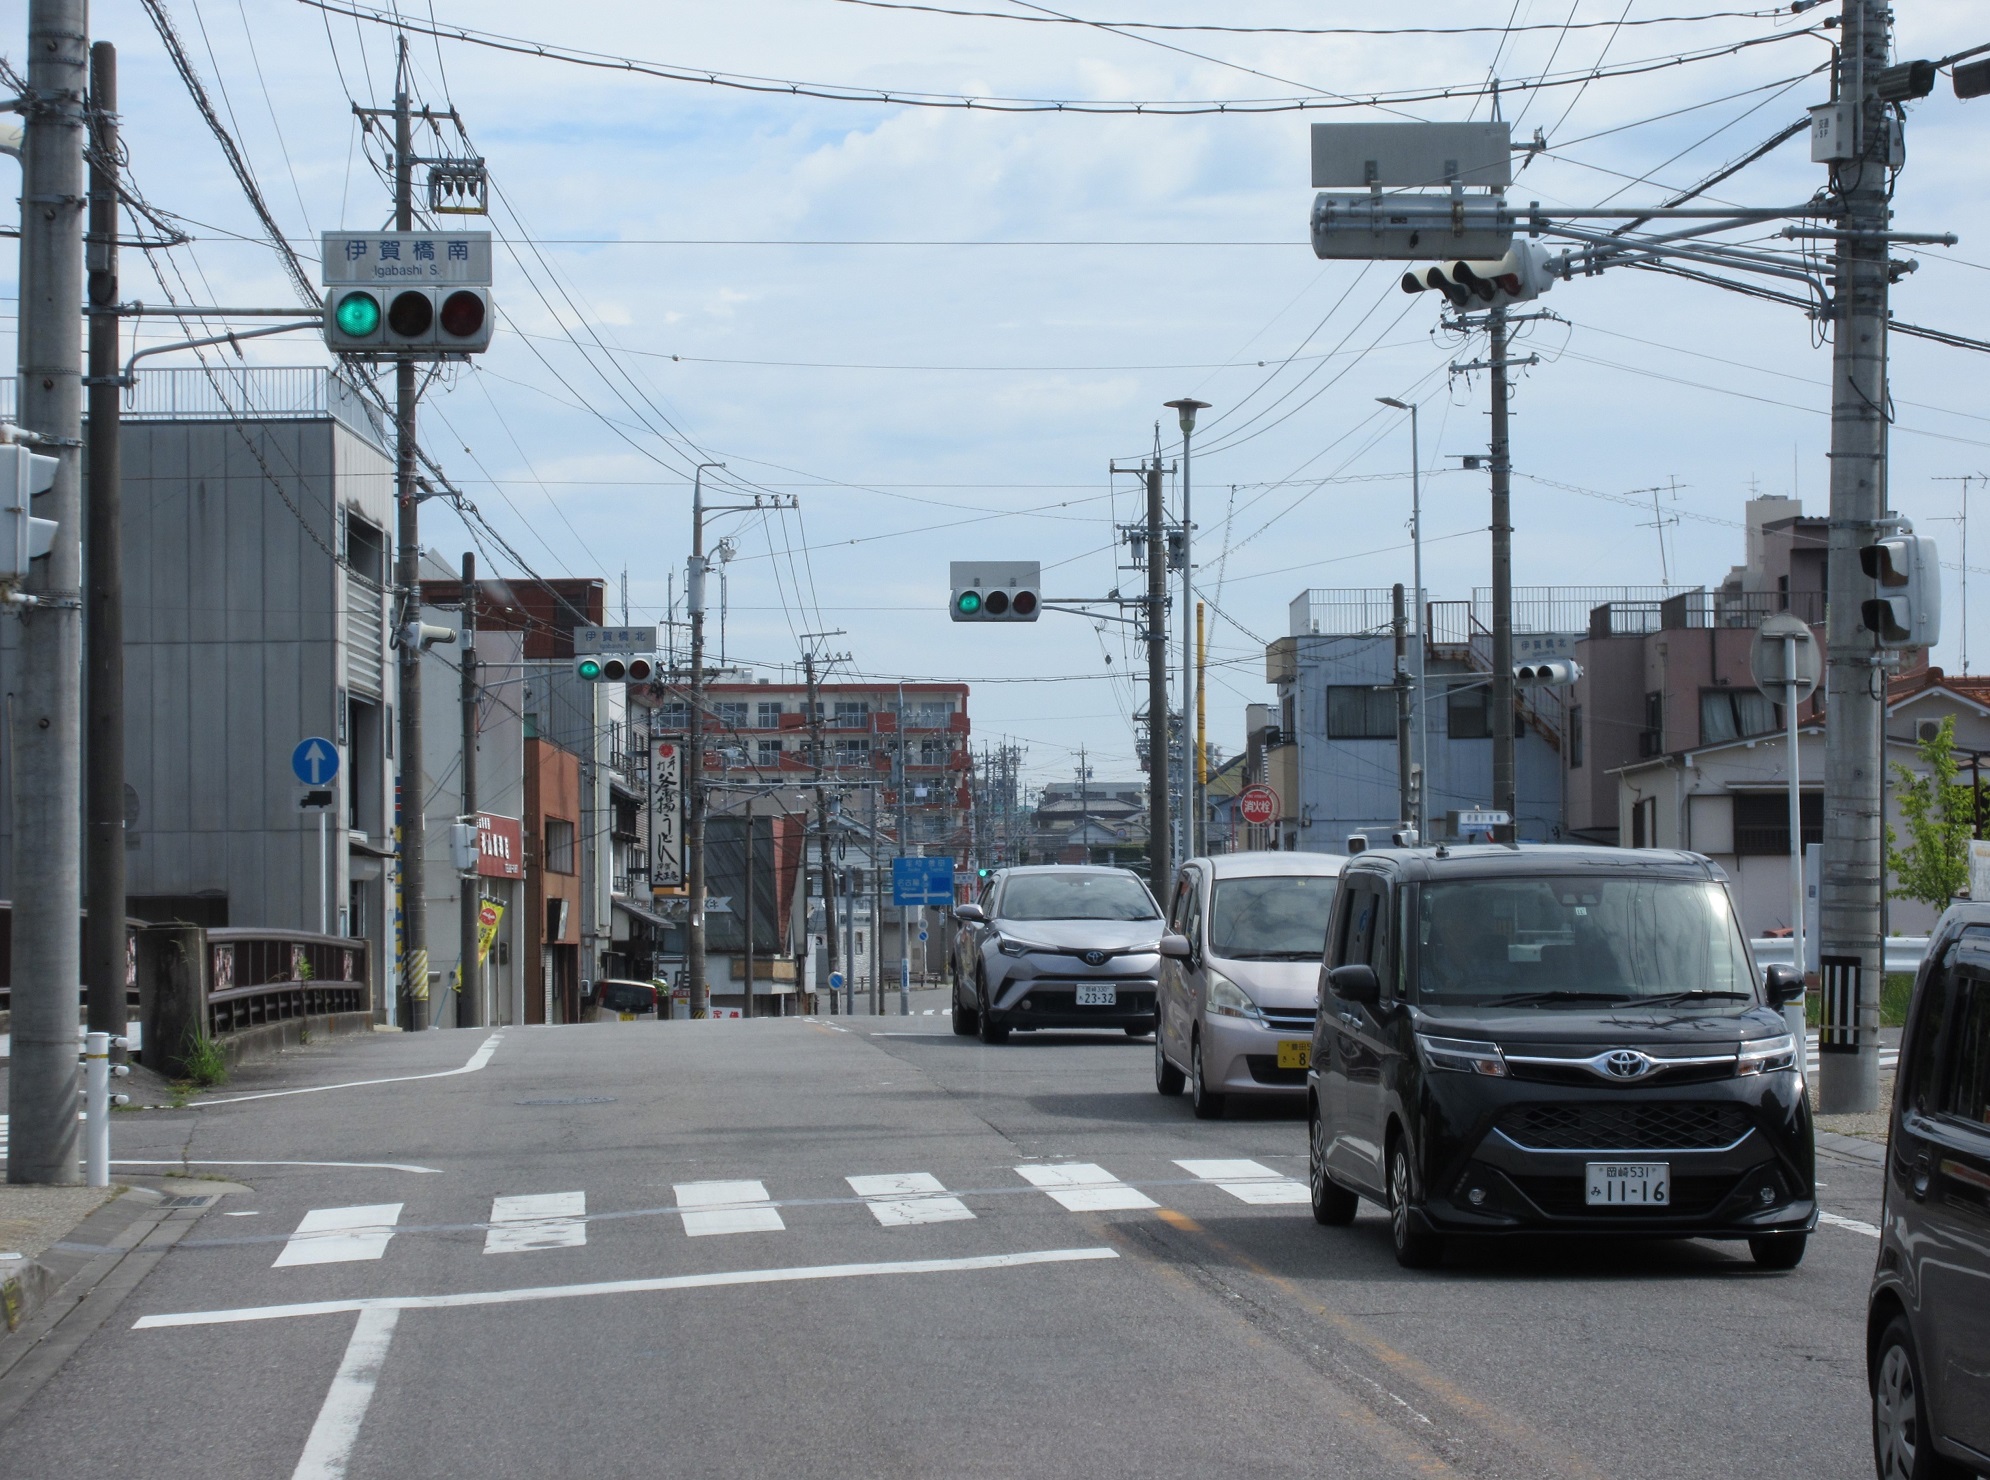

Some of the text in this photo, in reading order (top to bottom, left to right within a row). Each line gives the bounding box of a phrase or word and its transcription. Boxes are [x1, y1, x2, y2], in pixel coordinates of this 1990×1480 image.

[345, 239, 469, 261] 伊賀橋南
[374, 264, 423, 279] Igabashi
[585, 630, 647, 642] 伊賀橋北
[1244, 800, 1271, 813] 消火栓
[1084, 993, 1114, 1004] 23-32
[1607, 1180, 1665, 1202] 11-16
